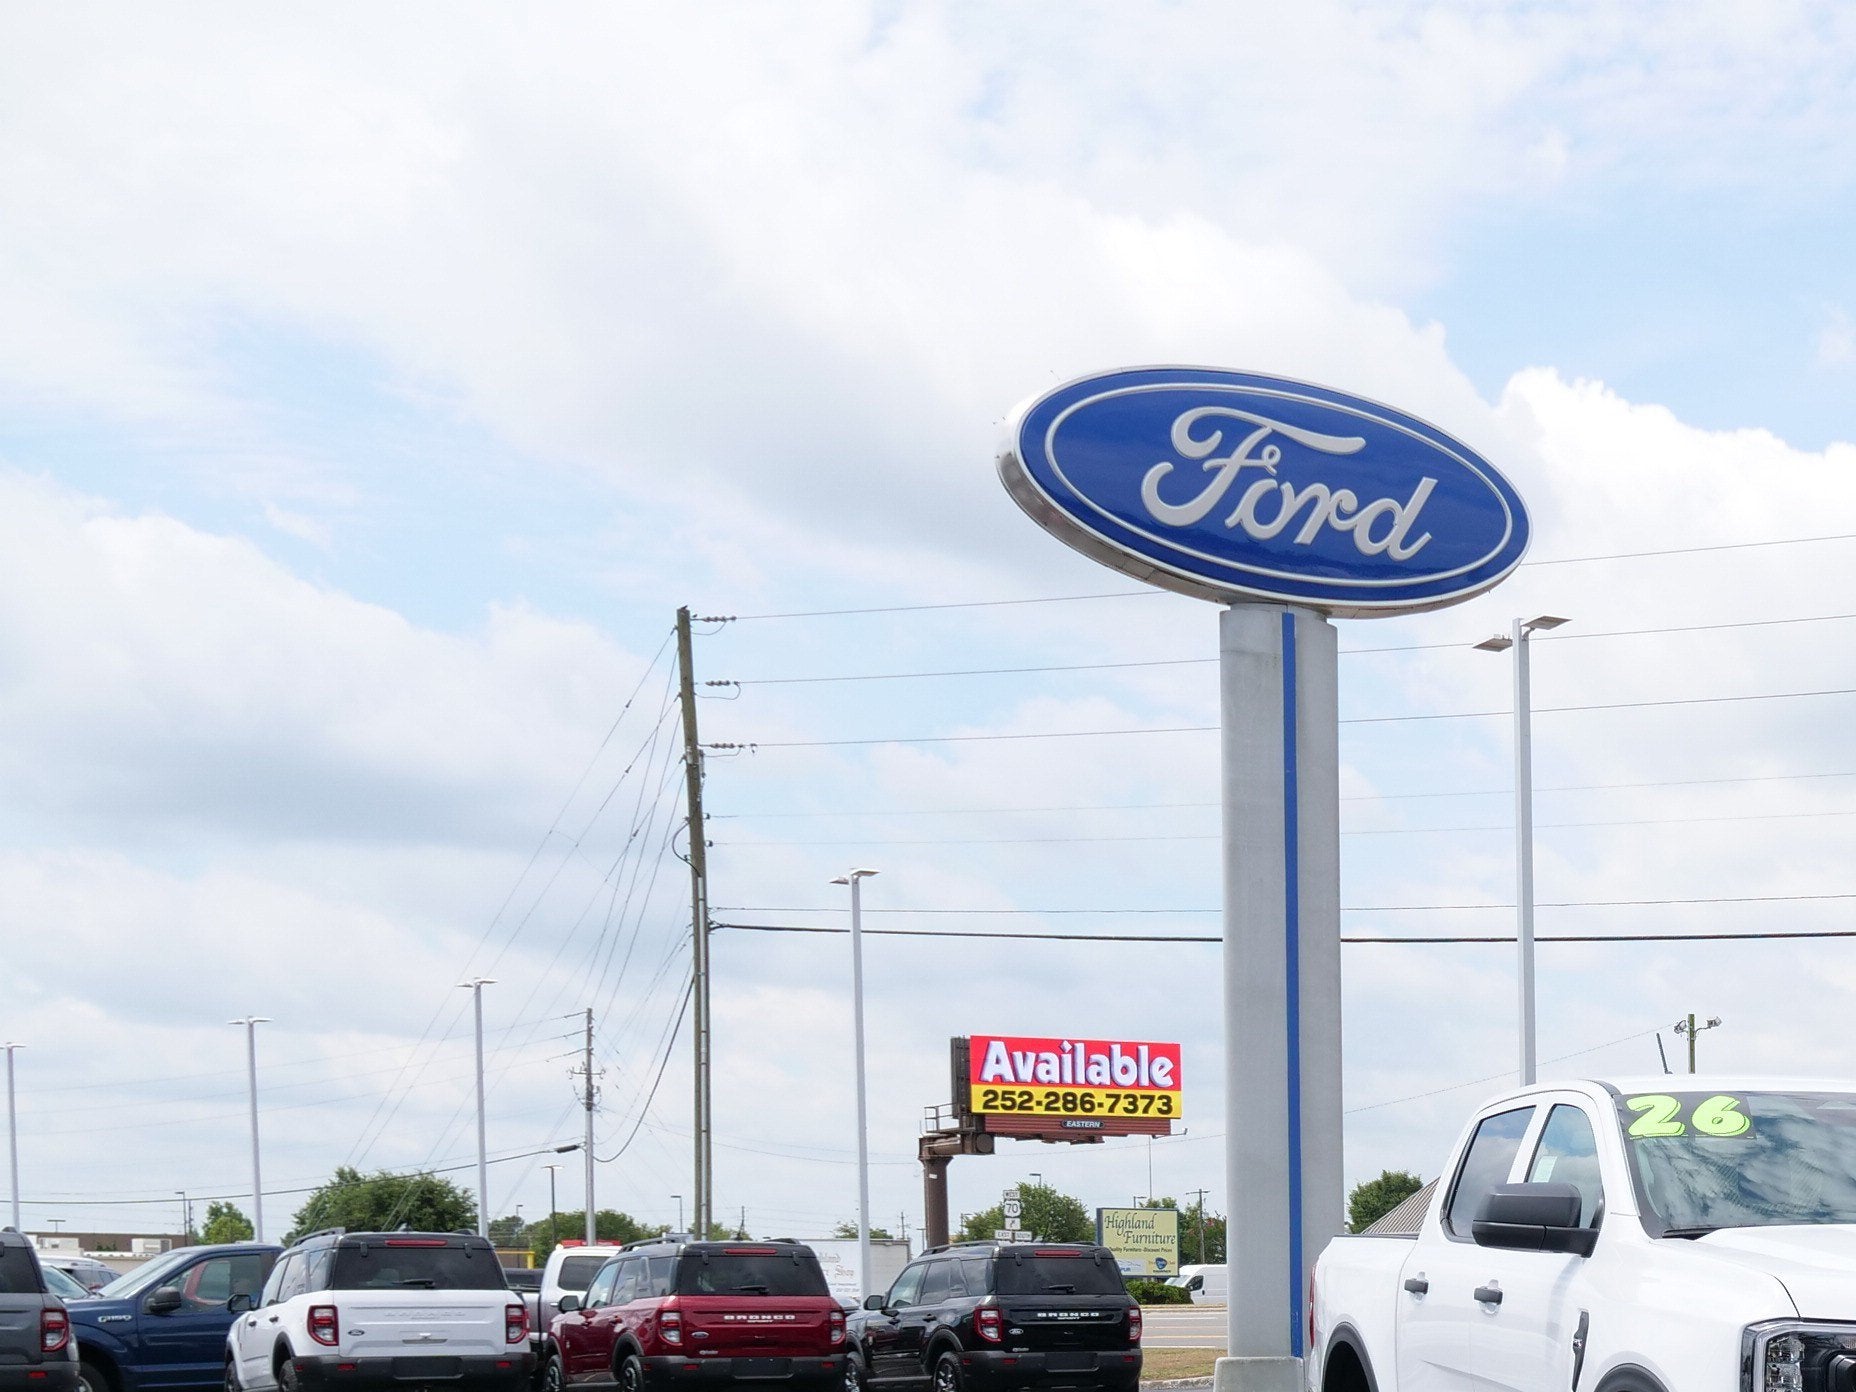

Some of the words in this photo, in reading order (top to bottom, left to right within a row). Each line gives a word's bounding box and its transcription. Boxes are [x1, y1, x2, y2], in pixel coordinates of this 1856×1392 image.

[1141, 406, 1438, 562] Ford
[980, 1040, 1174, 1087] Available
[982, 1089, 1173, 1115] 252-286-7373
[1065, 1120, 1101, 1128] EASTERN
[1626, 1095, 1750, 1137] 26
[1006, 1203, 1019, 1213] 70
[1104, 1211, 1157, 1236] Highland
[1124, 1230, 1176, 1244] Furniture
